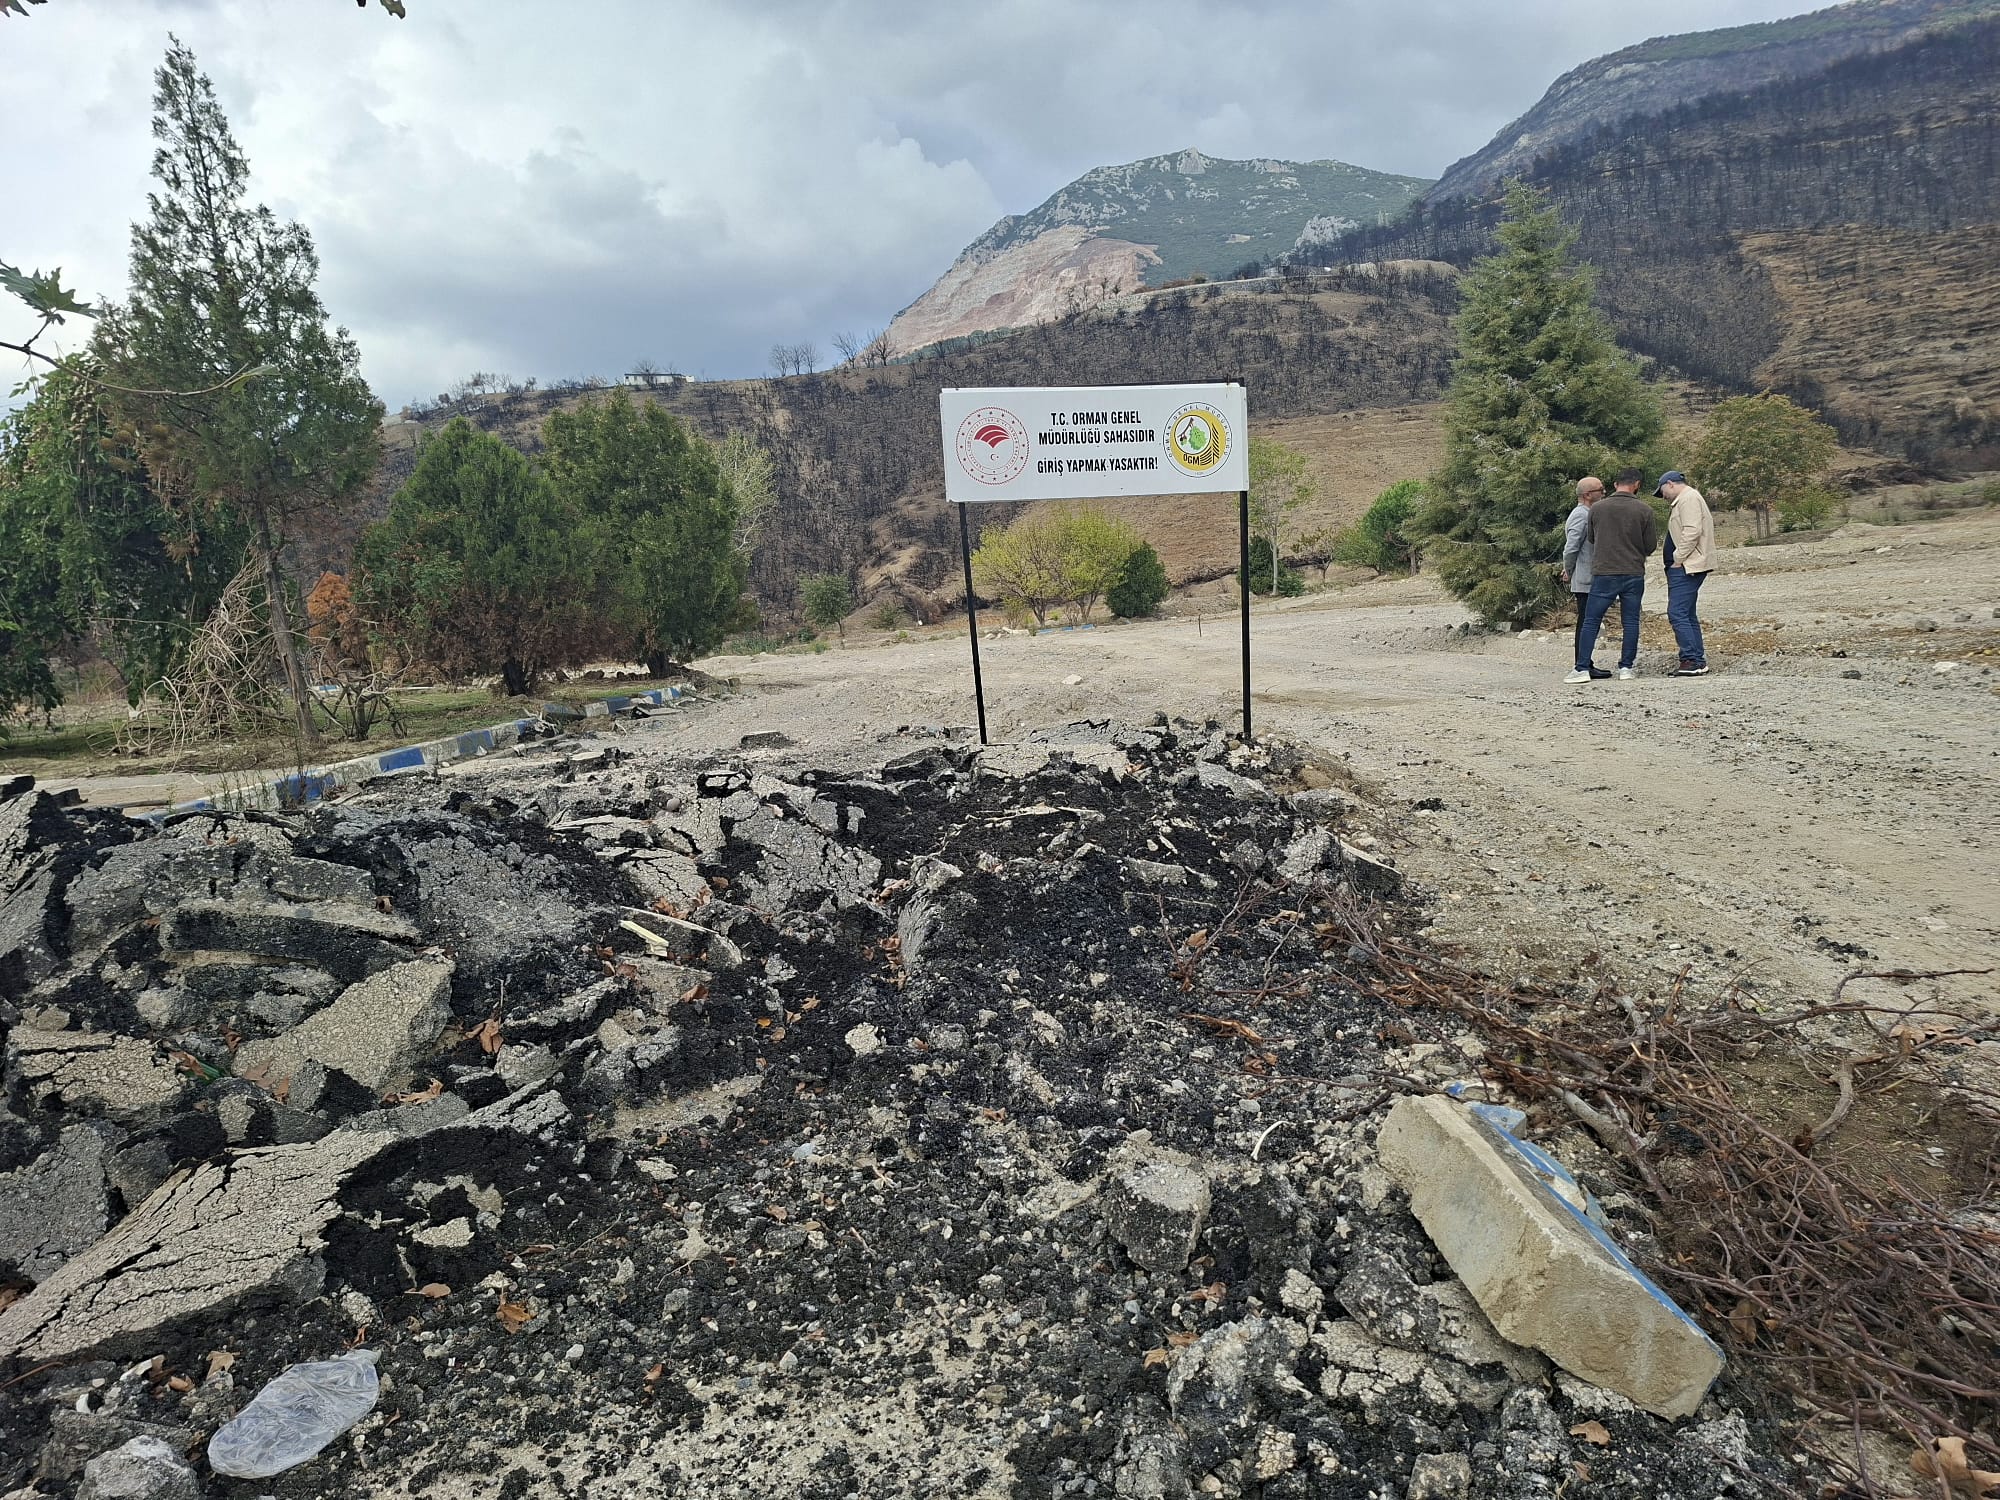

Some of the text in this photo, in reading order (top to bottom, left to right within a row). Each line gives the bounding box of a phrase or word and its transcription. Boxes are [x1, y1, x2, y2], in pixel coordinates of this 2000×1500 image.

[1050, 410, 1141, 426] T.C. ORMAN GENEL
[1038, 428, 1155, 445] MÜDÜRLÜĞÜ SAHASIDIR
[1037, 457, 1158, 476] GİRİŞ YAPMAK YASAKTIR!
[1183, 453, 1200, 466] OGM
